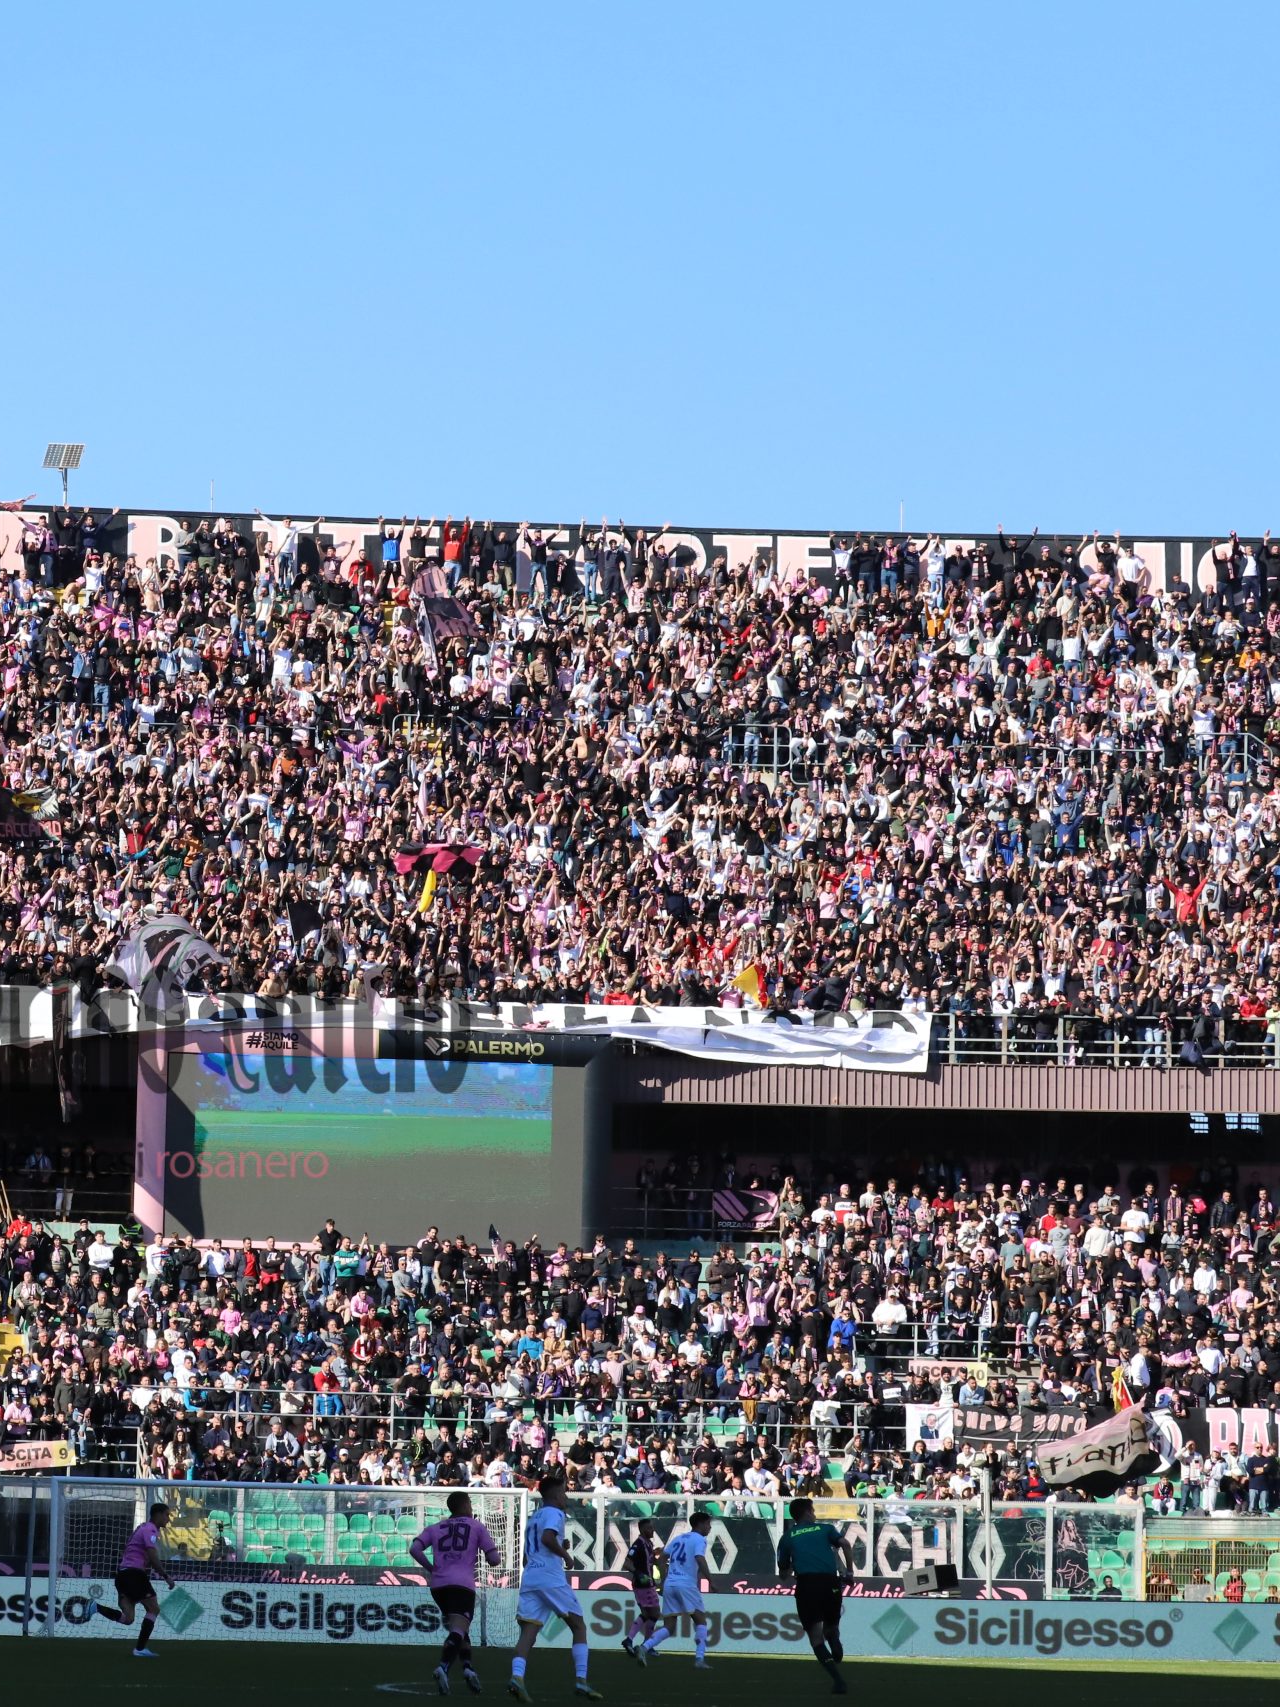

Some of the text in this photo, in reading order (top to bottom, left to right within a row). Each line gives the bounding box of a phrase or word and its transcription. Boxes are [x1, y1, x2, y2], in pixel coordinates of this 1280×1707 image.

[260, 1041, 300, 1051] AQUILE
[453, 1039, 545, 1057] PALERMO
[910, 1365, 961, 1378] USCT
[59, 1447, 69, 1460] 9
[437, 1522, 471, 1552] 28
[791, 1525, 822, 1538] LEGEA
[669, 1541, 687, 1565] 24
[220, 1589, 449, 1640] Sicilgess
[590, 1598, 806, 1648] Sigess
[933, 1606, 1174, 1655] Sicilgesso
